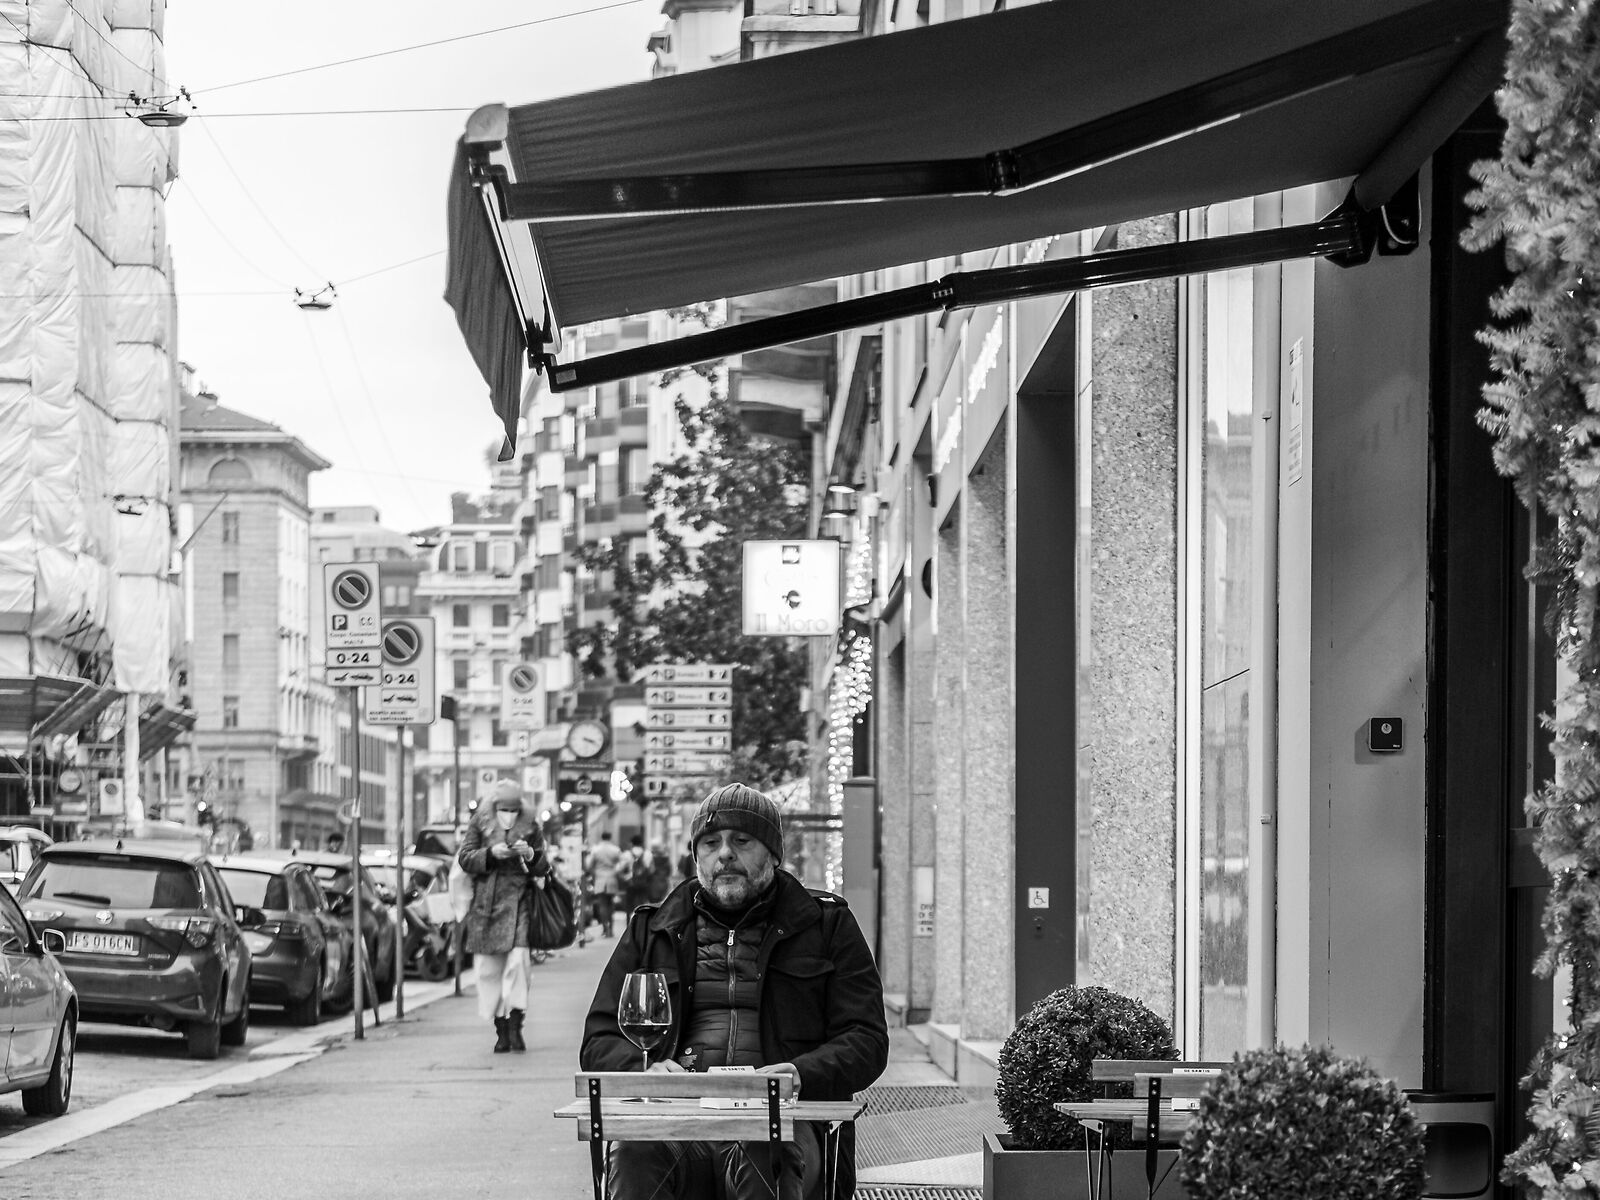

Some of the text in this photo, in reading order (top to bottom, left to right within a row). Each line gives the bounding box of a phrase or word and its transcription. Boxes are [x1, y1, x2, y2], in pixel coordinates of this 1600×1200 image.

[778, 613, 829, 632] Moro
[336, 652, 369, 664] 0-24
[384, 674, 415, 684] 0-24
